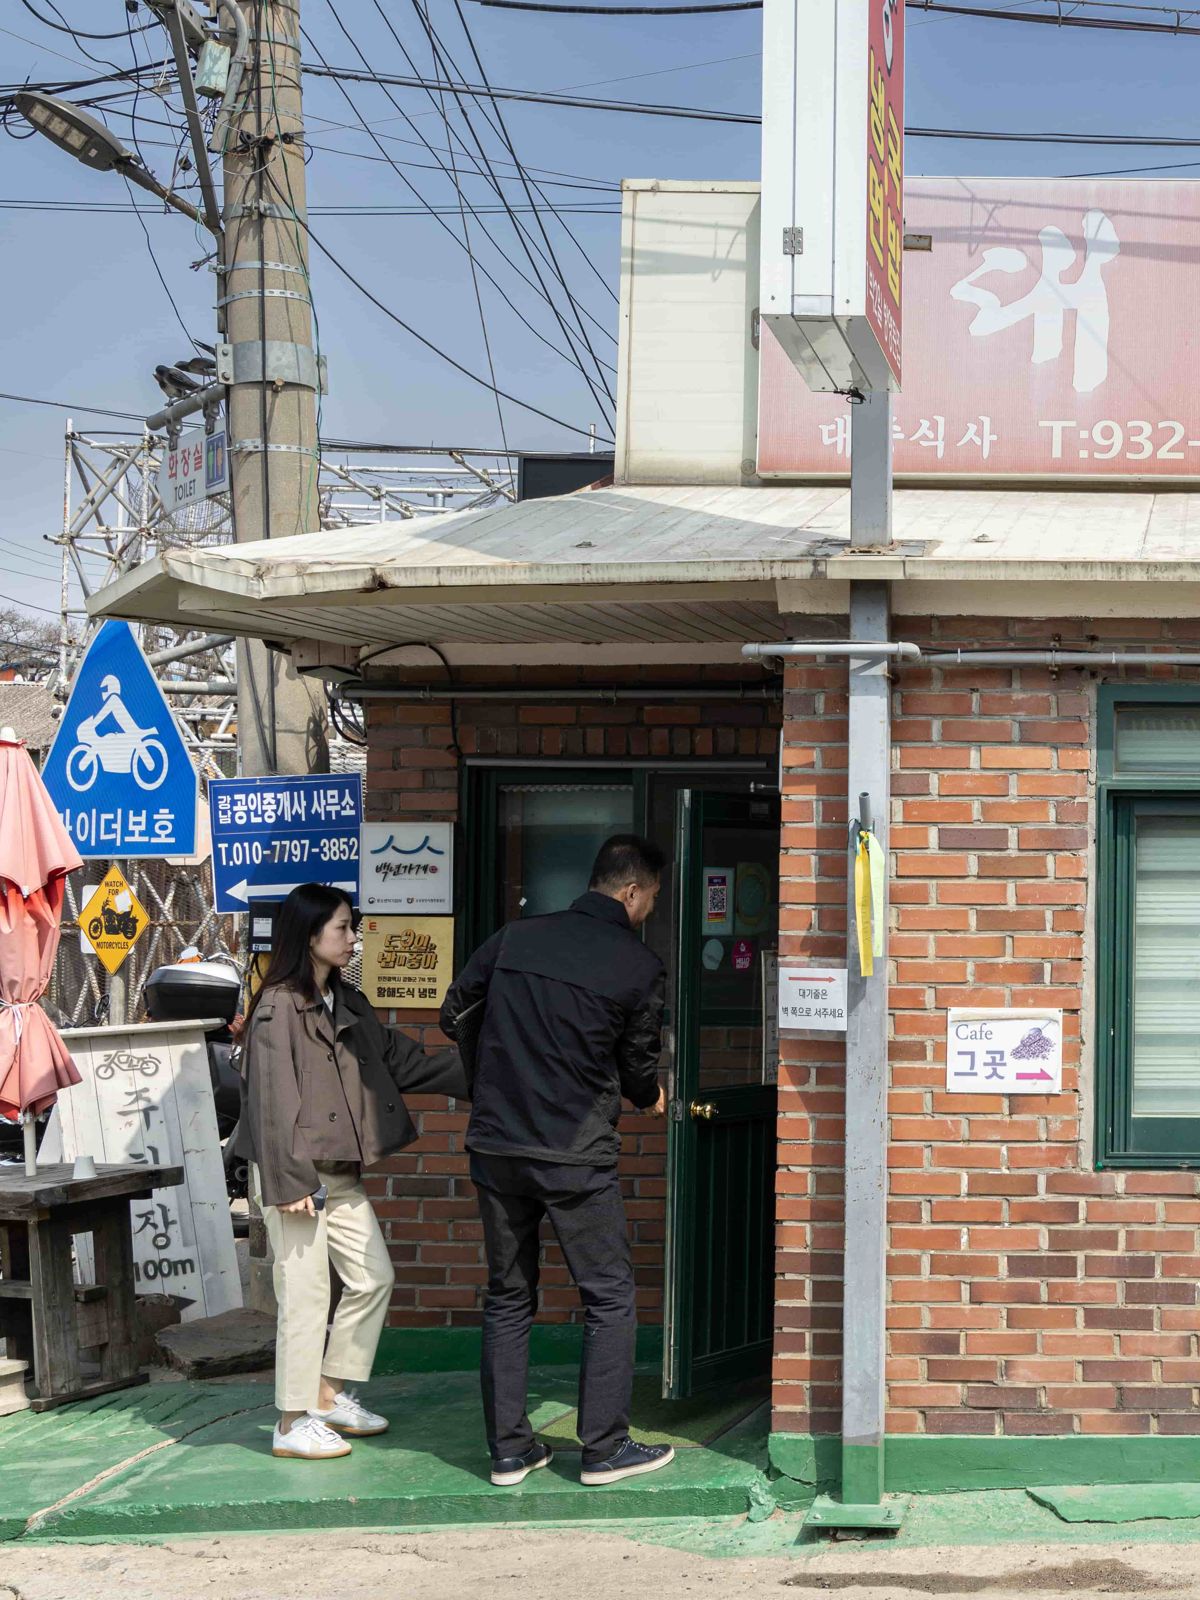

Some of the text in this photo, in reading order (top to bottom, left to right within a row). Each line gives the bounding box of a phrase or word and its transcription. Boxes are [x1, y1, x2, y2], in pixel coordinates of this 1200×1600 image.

[168, 441, 203, 480] 화장실
[174, 478, 196, 503] TOILET
[232, 790, 307, 825] 공인중개사
[311, 788, 356, 821] 사무소
[217, 837, 359, 867] T.010-7797-3852
[375, 862, 429, 882] 백년가게
[377, 986, 437, 999] 황해도식 냉면
[798, 988, 828, 1000] 대기줄은
[790, 1006, 812, 1017] 쪽으로
[814, 1007, 844, 1019] 서주세요
[955, 1022, 993, 1041] Cafe
[953, 1050, 1007, 1080] 그곳
[133, 1257, 196, 1283] 100m
